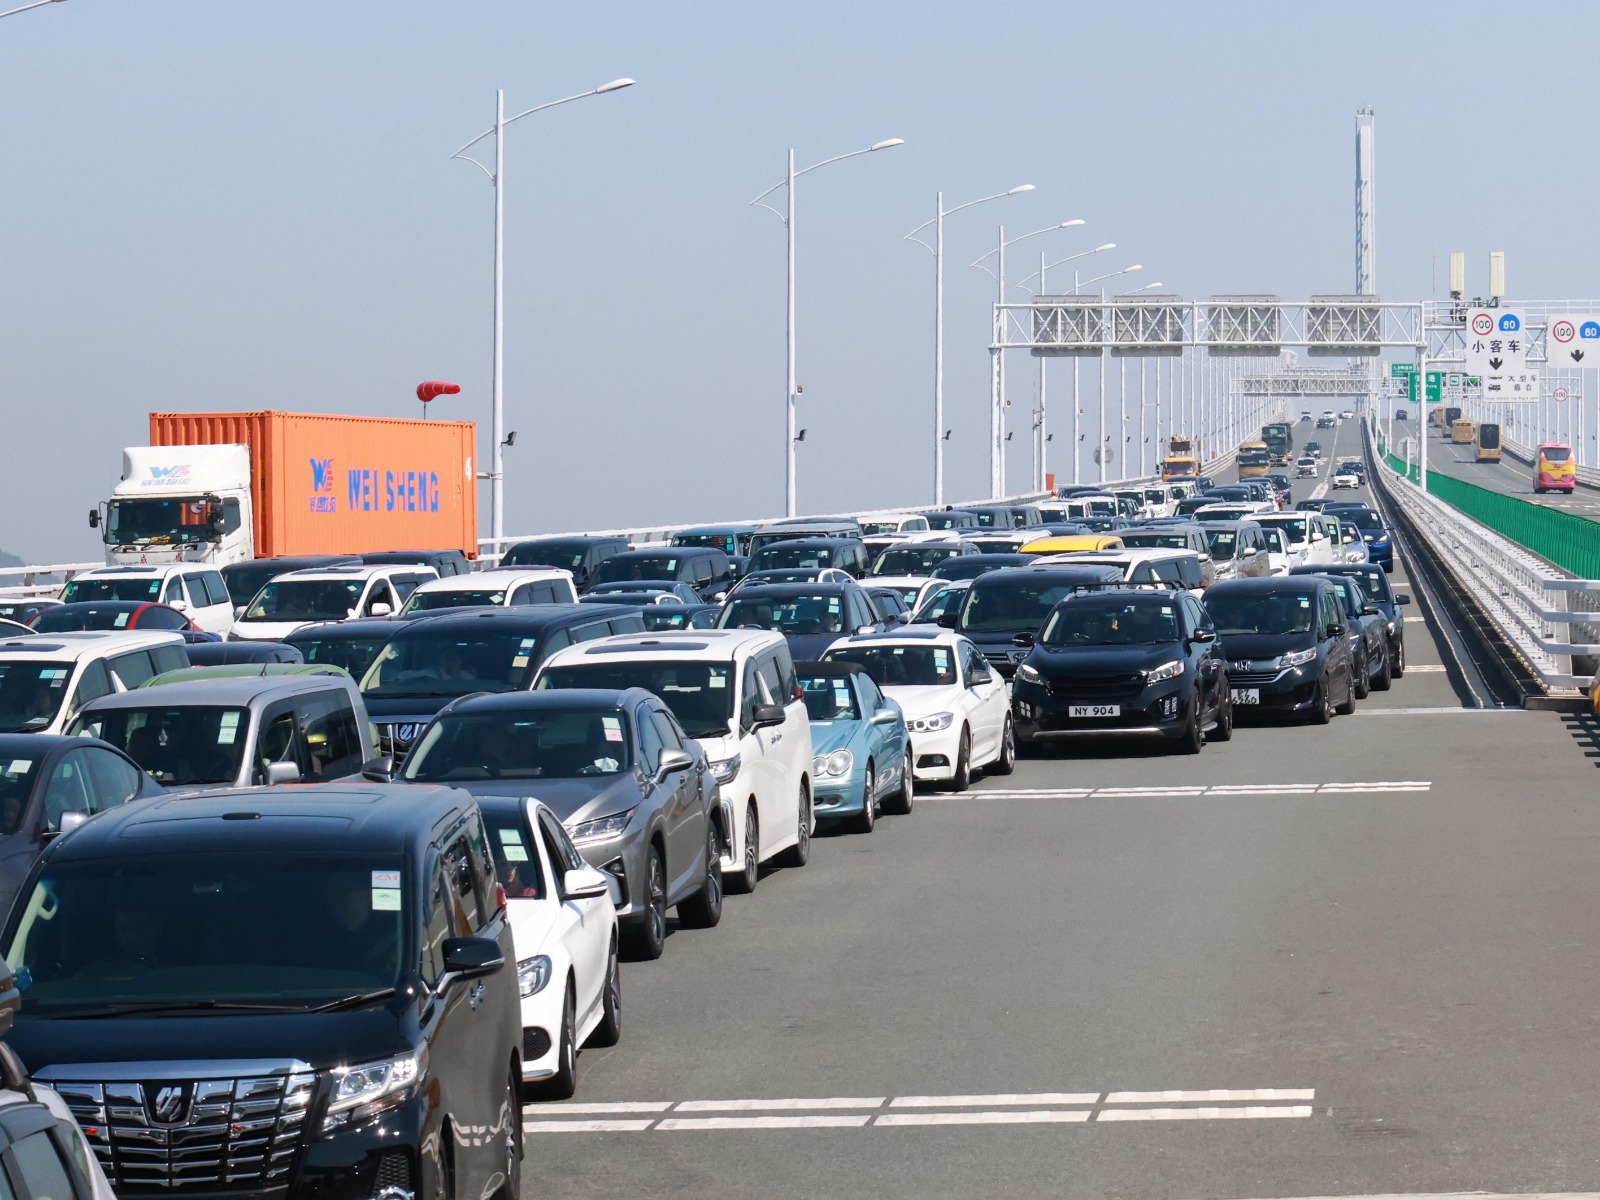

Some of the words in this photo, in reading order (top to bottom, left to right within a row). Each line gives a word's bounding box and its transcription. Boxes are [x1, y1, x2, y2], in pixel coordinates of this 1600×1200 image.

[1475, 320, 1491, 329] 100
[1503, 320, 1516, 330] 80
[1556, 328, 1572, 337] 100
[1584, 327, 1597, 337] 80
[1472, 340, 1520, 353] 小客车
[1508, 374, 1538, 383] 大型车
[465, 456, 473, 481] 4
[348, 469, 378, 512] WEI
[386, 470, 439, 513] SHENG
[1074, 707, 1088, 716] NY
[1092, 706, 1114, 716] 904
